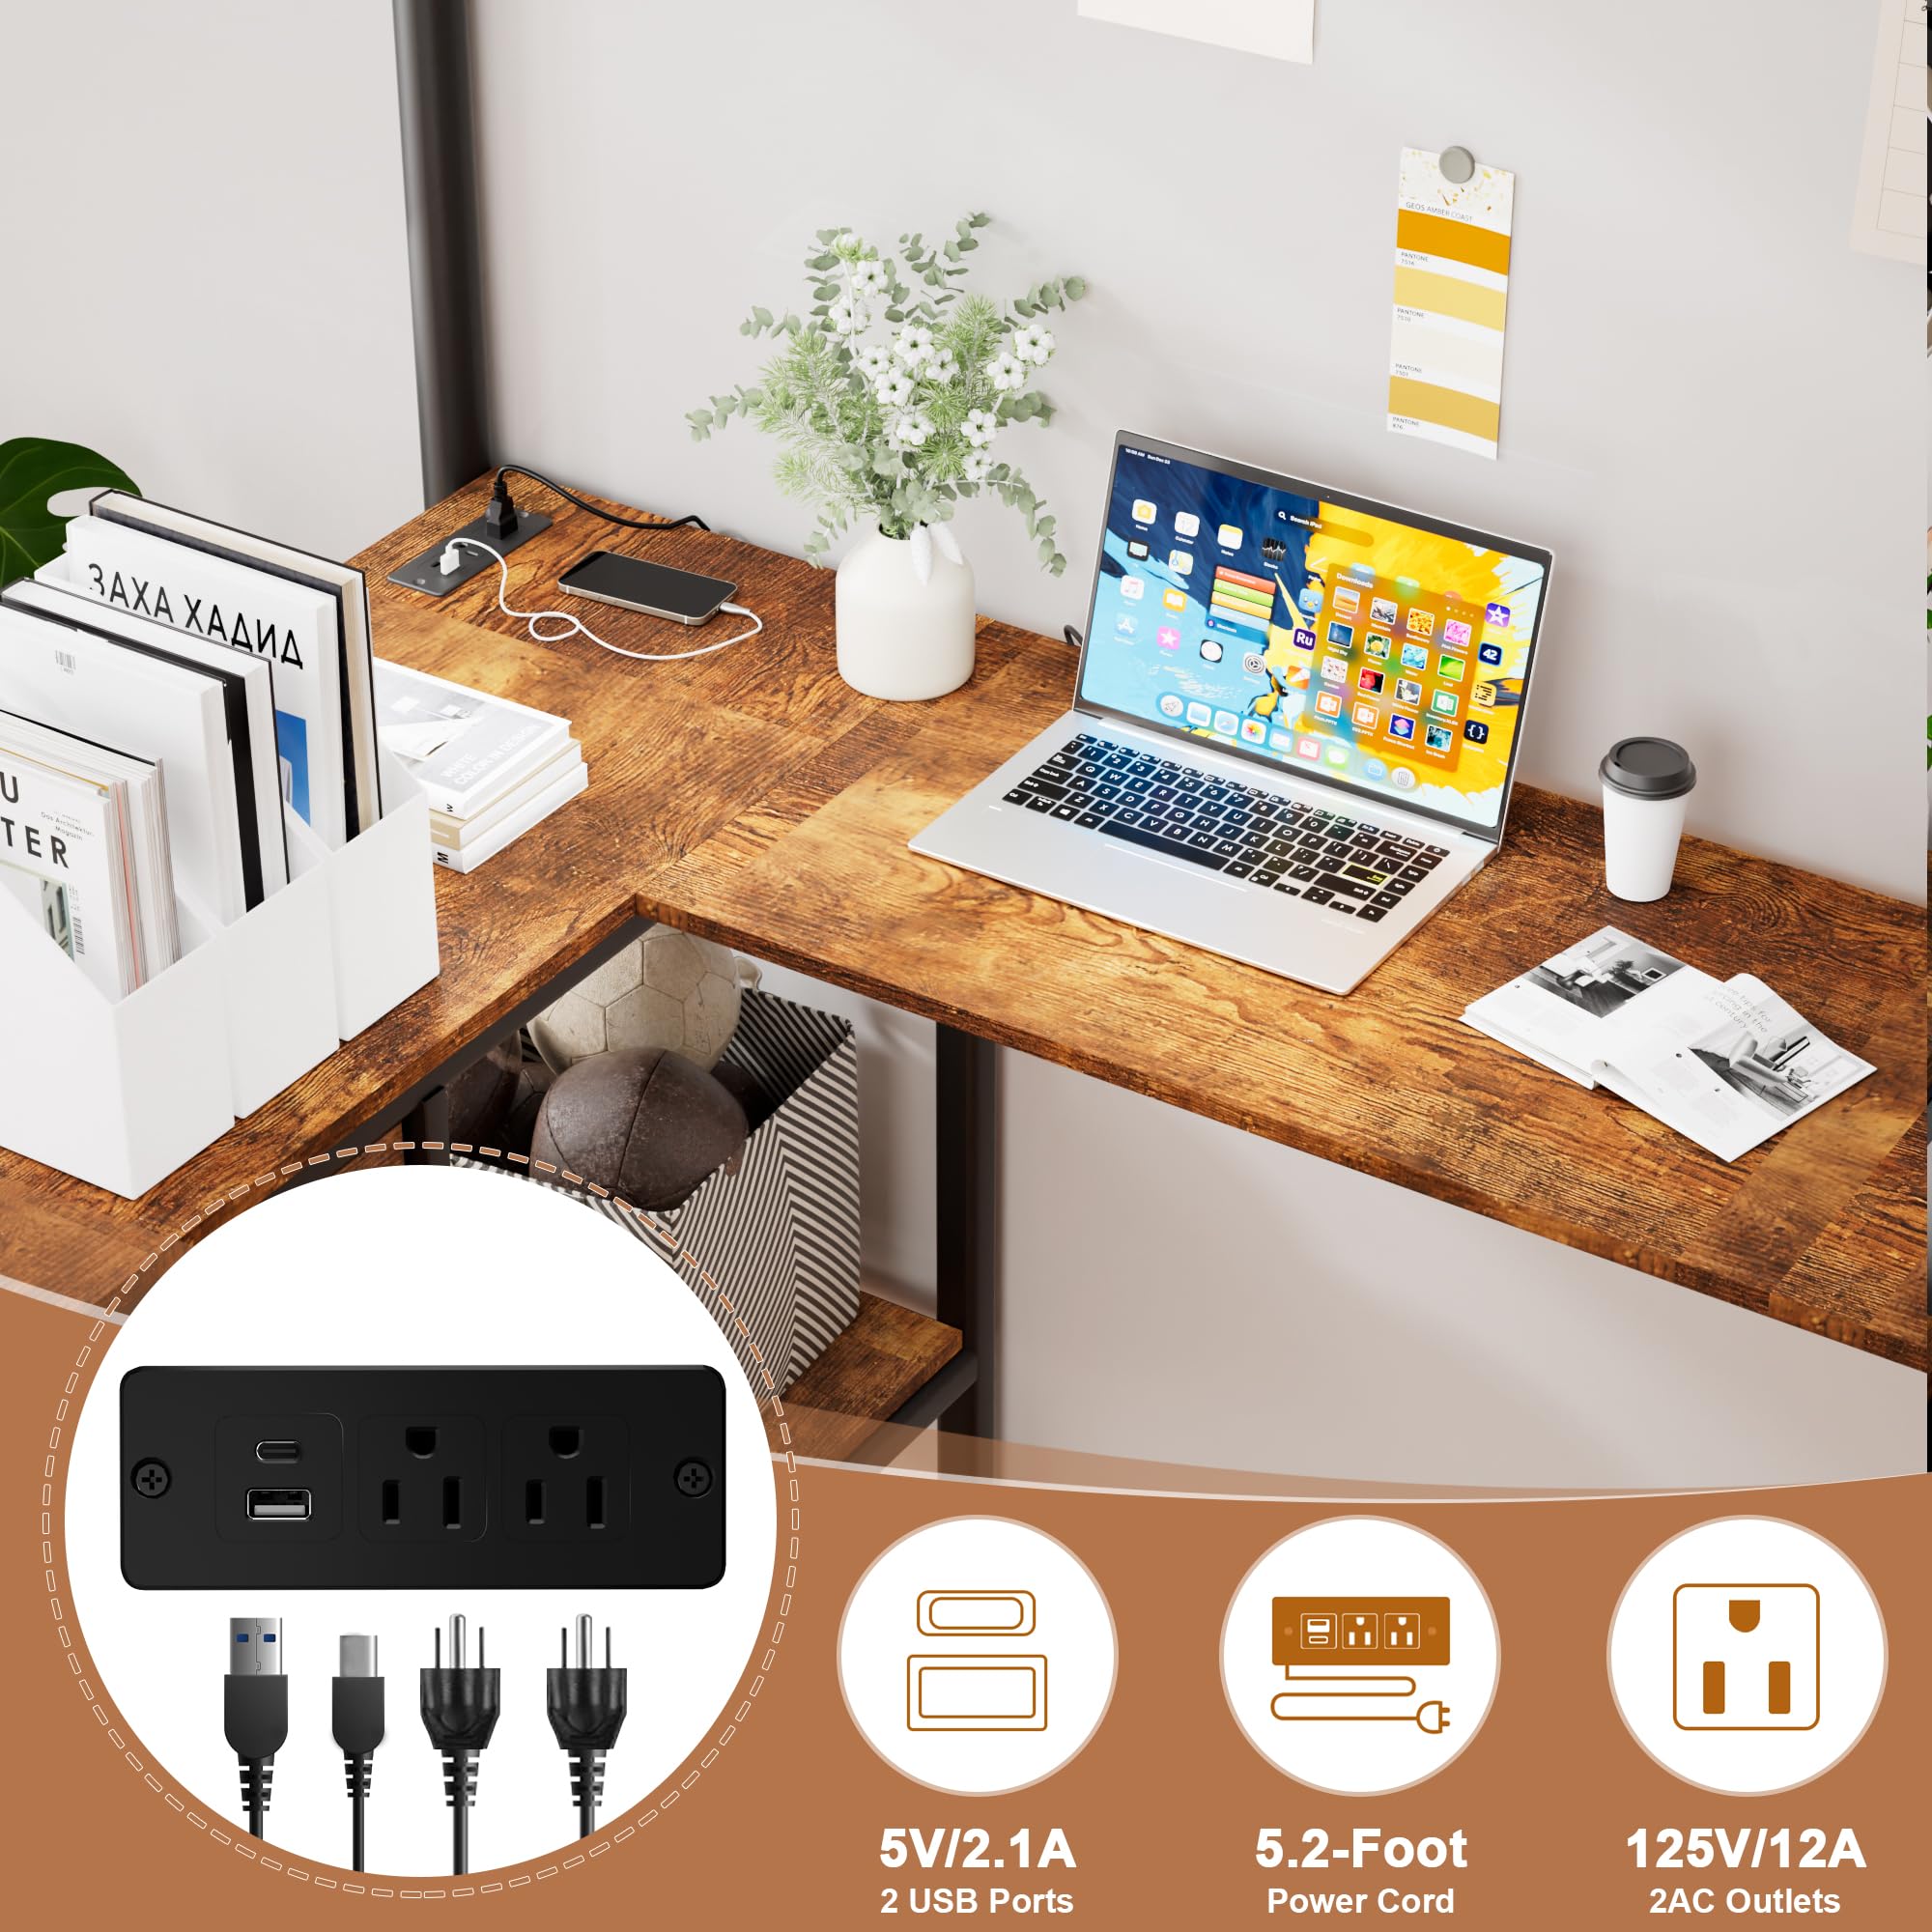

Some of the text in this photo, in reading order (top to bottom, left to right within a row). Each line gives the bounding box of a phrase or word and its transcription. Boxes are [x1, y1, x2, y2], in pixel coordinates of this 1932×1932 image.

[1406, 202, 1425, 211] GEOS
[1401, 251, 1429, 262] PANTONE
[1397, 307, 1425, 317] PANTONE
[1395, 363, 1422, 373] PANTONE
[1392, 416, 1419, 426] PANTONE
[1337, 572, 1374, 588] Downloads
[89, 563, 303, 669] ЗАХА ХАДИД
[1296, 632, 1313, 646] Ru
[1482, 648, 1498, 662] 42
[1715, 1001, 1748, 1029] century
